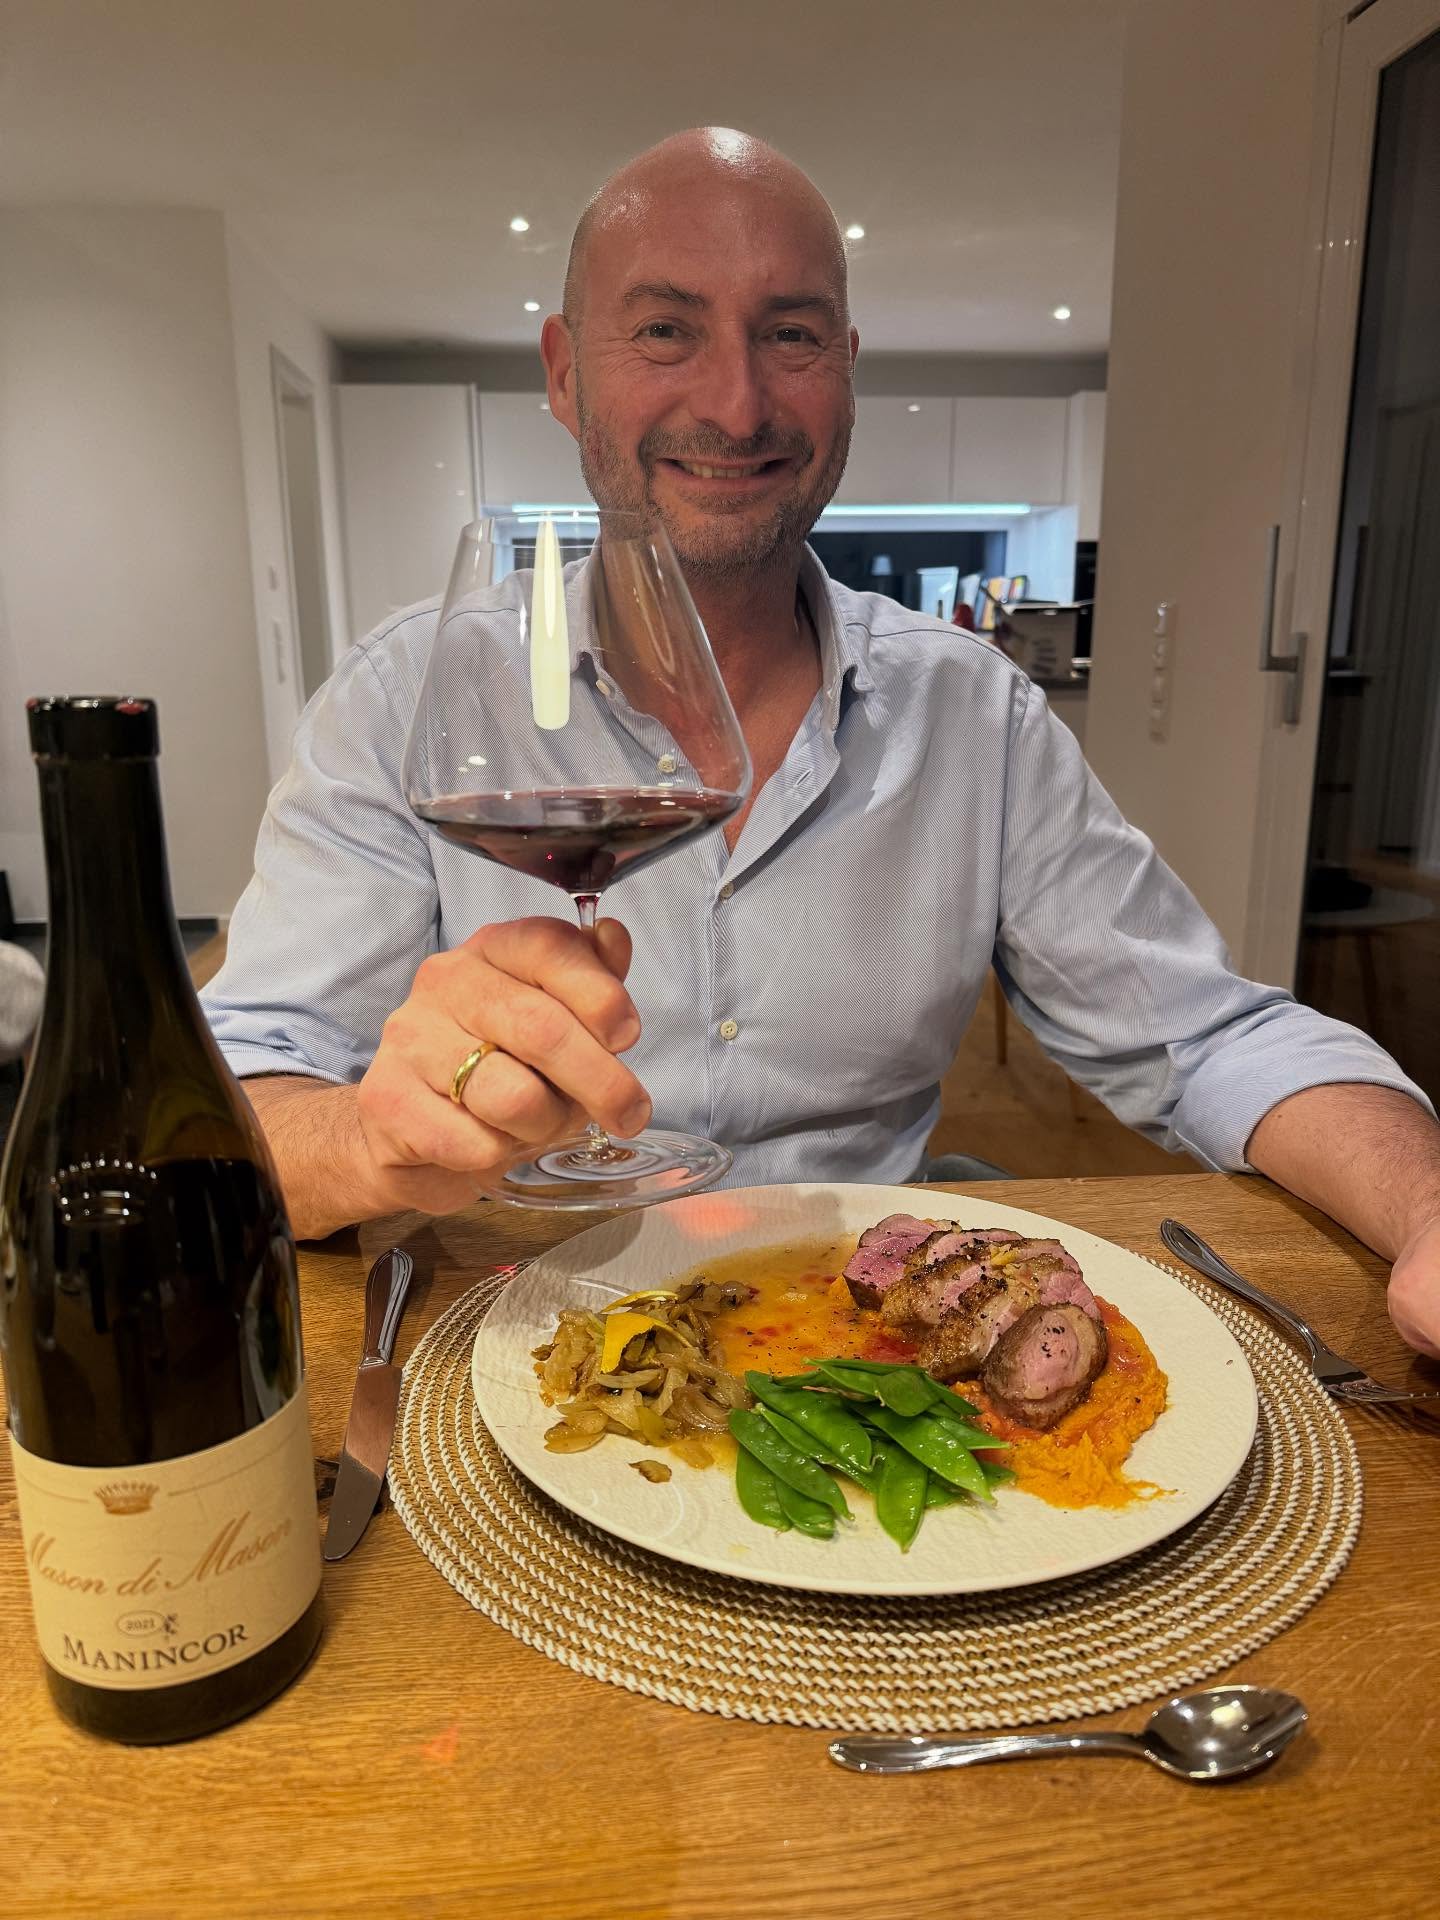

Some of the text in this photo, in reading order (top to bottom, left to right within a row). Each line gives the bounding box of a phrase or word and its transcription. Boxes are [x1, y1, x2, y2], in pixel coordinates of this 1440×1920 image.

[116, 1557, 163, 1595] di
[164, 1511, 291, 1589] Mason
[63, 1623, 249, 1671] MANINCOR
